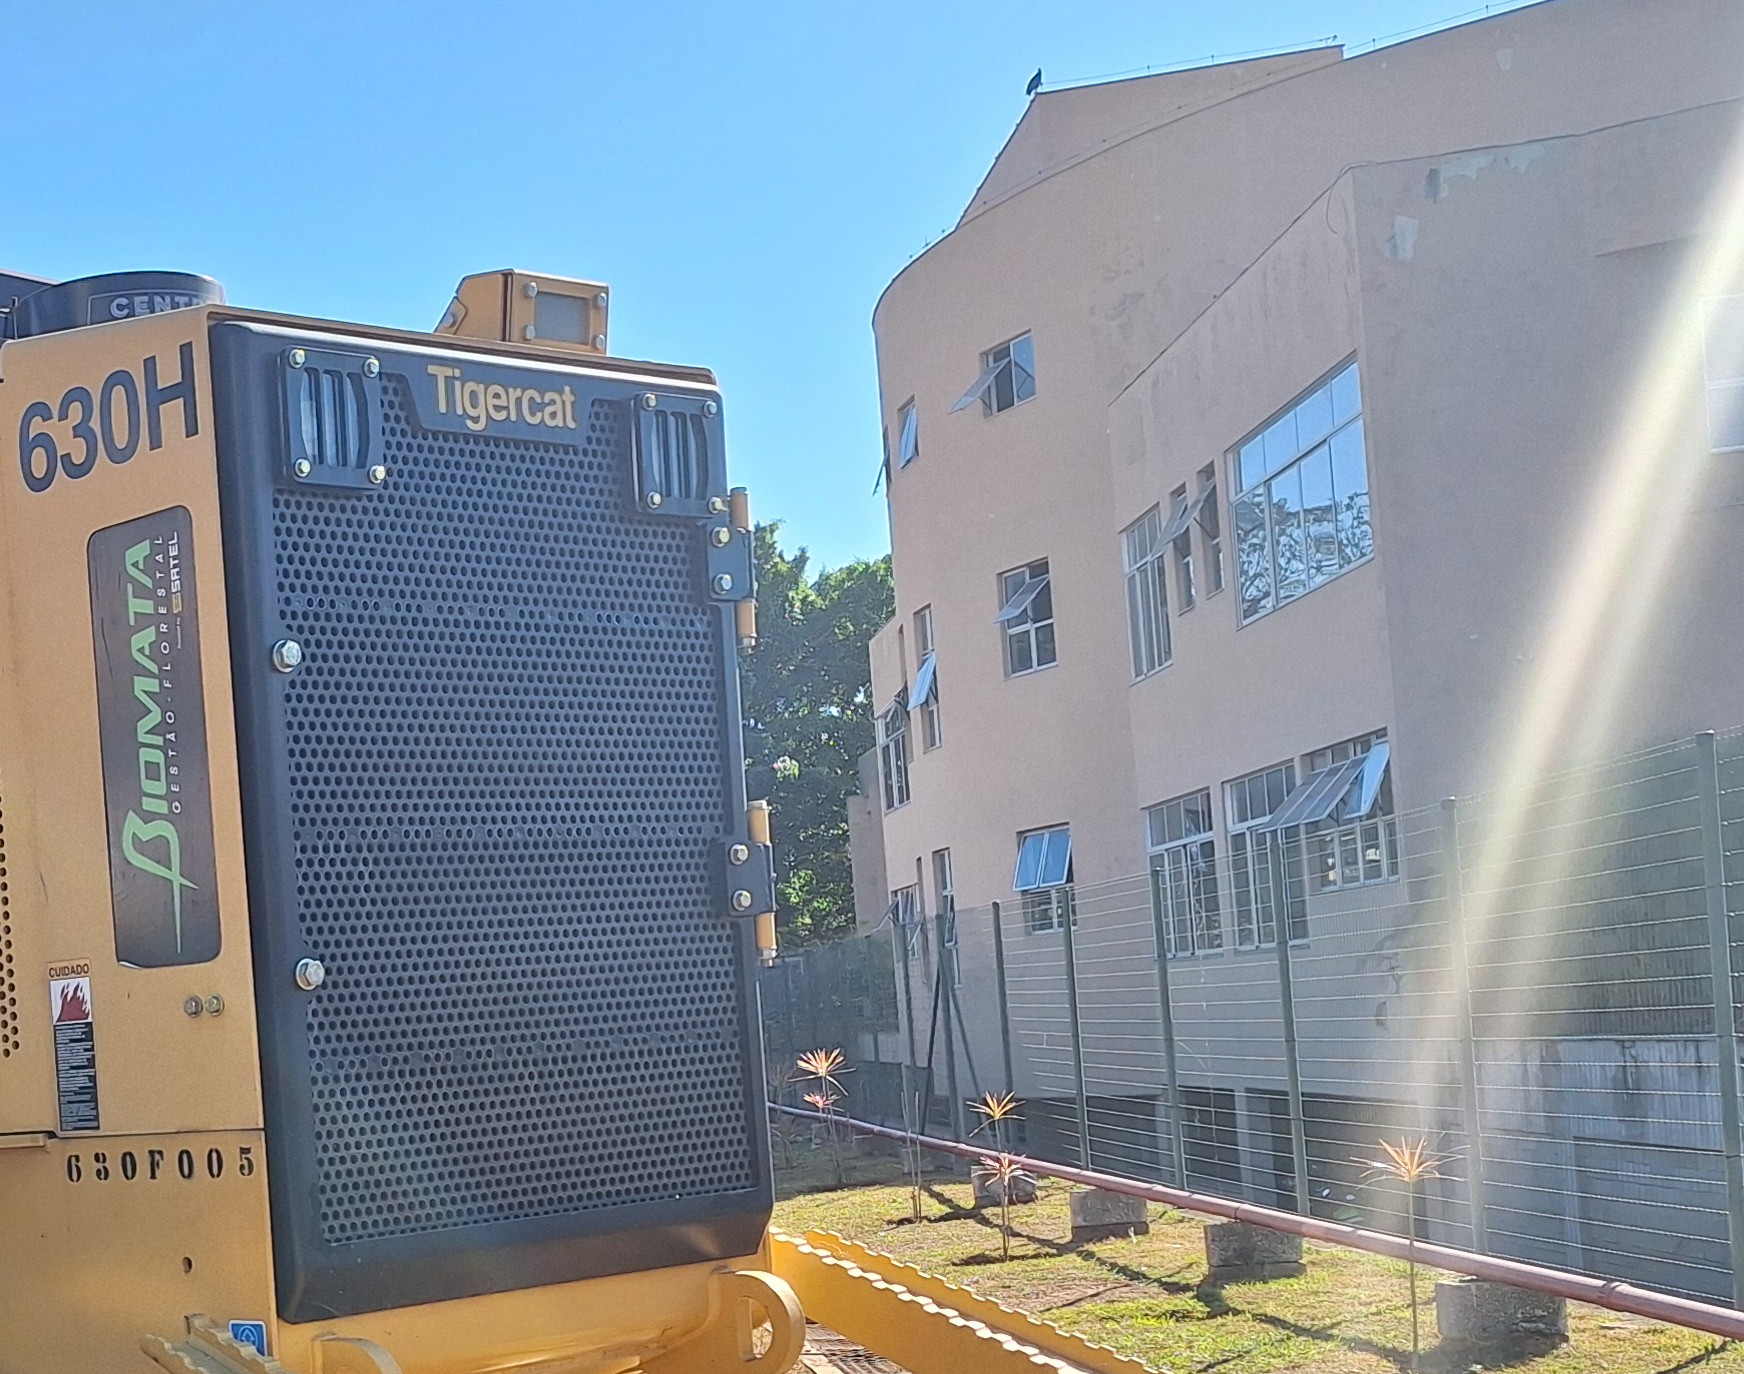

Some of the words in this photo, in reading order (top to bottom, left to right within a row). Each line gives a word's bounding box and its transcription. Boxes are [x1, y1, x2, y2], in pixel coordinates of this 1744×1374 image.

[19, 341, 199, 493] 630H
[427, 364, 577, 431] Tigercat
[49, 963, 90, 978] CUIDADO
[67, 1146, 254, 1183] 630F005
